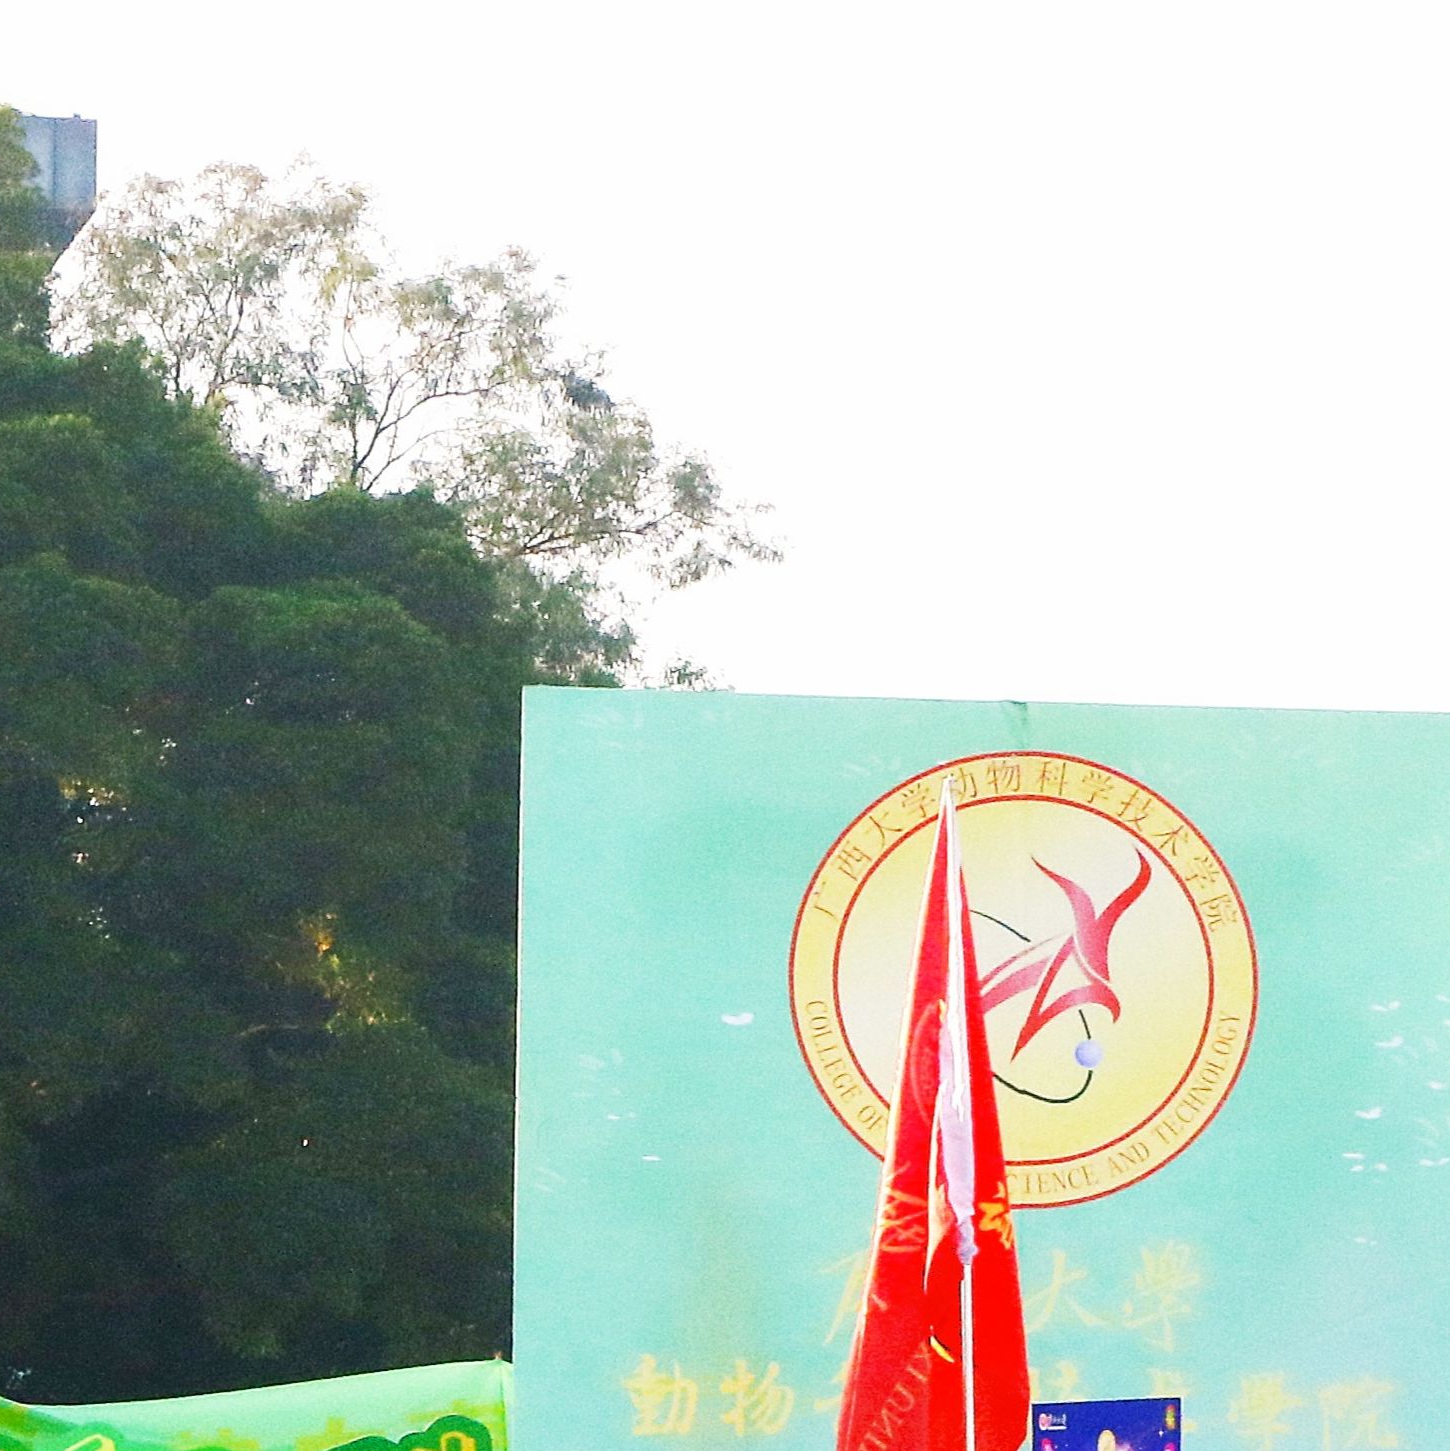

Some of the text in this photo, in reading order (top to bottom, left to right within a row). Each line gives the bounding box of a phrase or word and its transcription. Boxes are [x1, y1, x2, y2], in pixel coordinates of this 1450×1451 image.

[812, 759, 1240, 933] 广西大学动物科学技术学院
[805, 1000, 863, 1104] COLLEGE
[1005, 1165, 1099, 1196] CIENCE
[1107, 1141, 1151, 1177] AND
[1151, 1010, 1241, 1144] TECHNOLOGY
